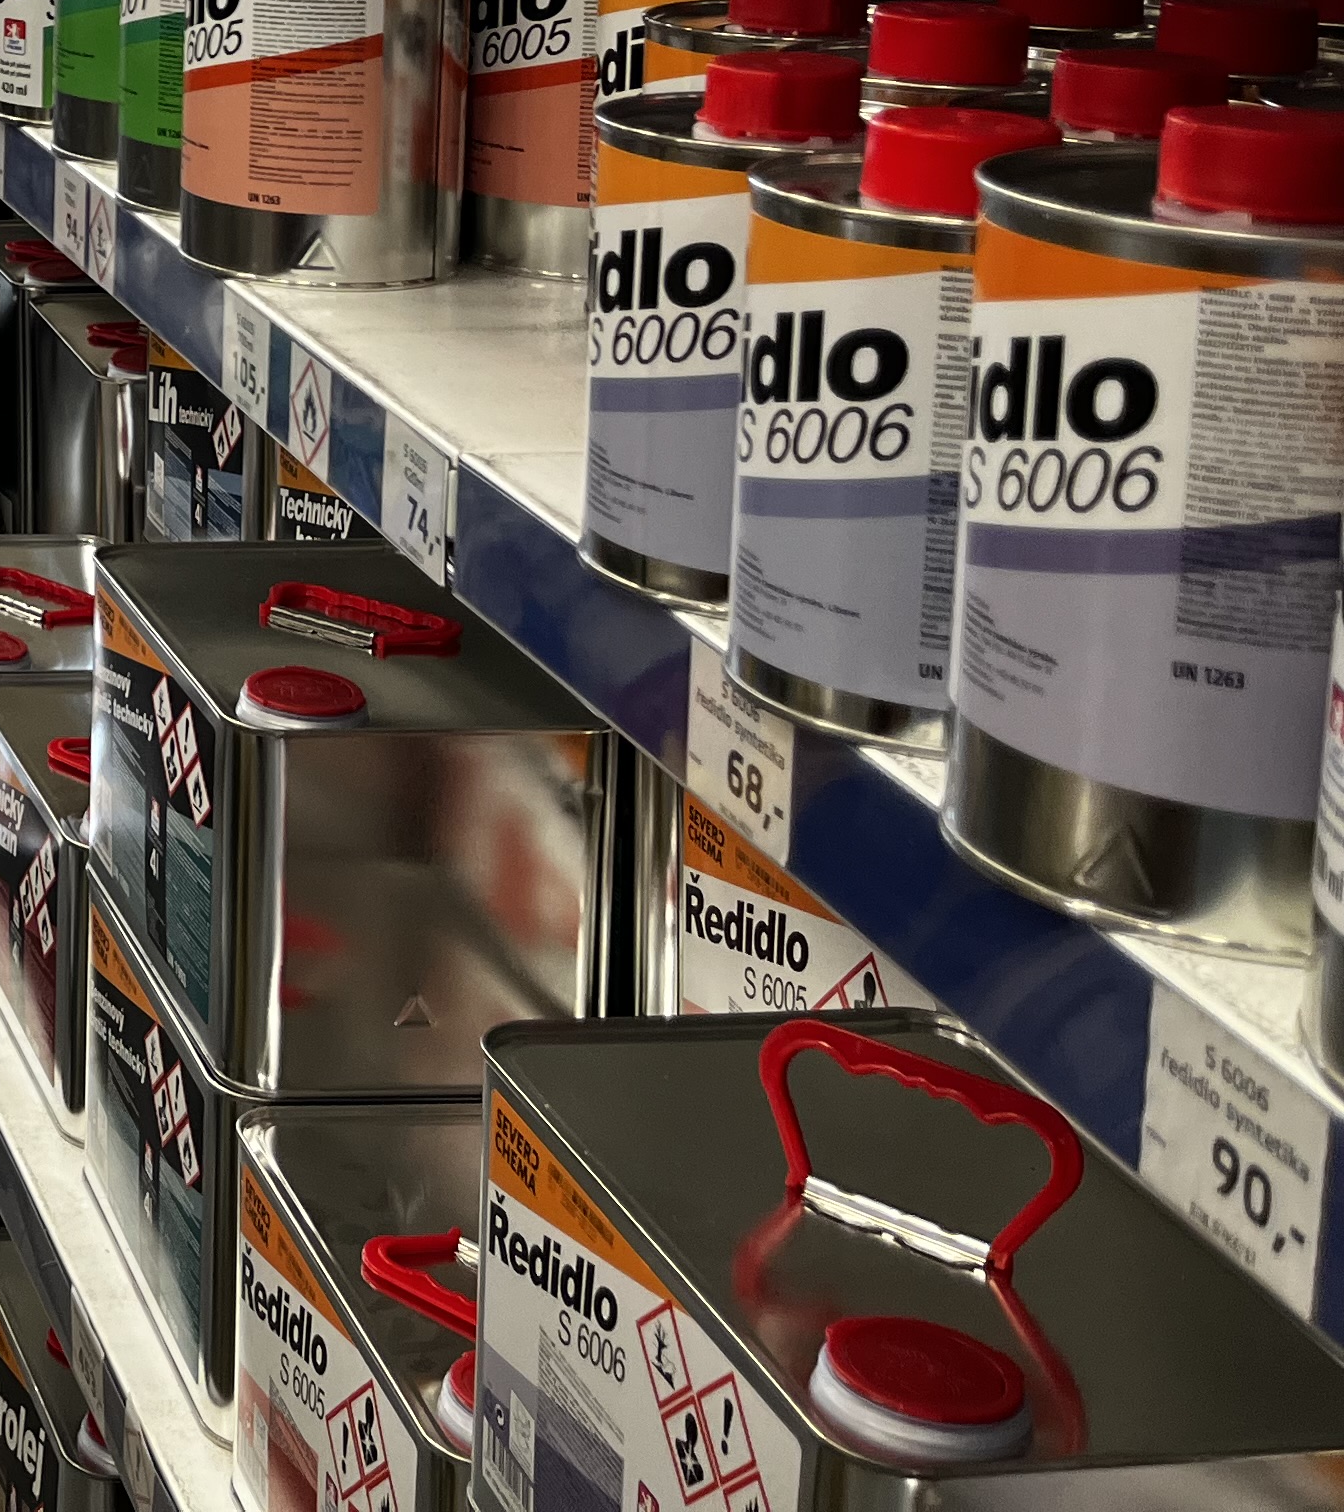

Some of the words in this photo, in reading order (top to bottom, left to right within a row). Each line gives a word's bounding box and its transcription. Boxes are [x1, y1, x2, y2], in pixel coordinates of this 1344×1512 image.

[186, 18, 243, 64] 6005
[483, 17, 572, 68] 6005
[611, 308, 739, 367] 6006
[149, 367, 179, 426] Líh
[178, 402, 215, 430] technický
[231, 348, 267, 405] 105,-
[765, 402, 913, 465] 6006
[279, 486, 354, 531] Technický
[965, 447, 985, 511] S
[996, 444, 1165, 515] 6006
[405, 493, 444, 554] 74,-
[918, 663, 943, 682] UN
[1172, 662, 1198, 683] UN
[1204, 665, 1245, 690] 1263
[724, 748, 786, 832] 68,-
[688, 803, 726, 849] SEVERO
[688, 823, 724, 868] CHEMA
[685, 872, 809, 975] Ředidlo
[742, 965, 757, 997] S
[761, 970, 808, 1012] 6005
[1205, 1045, 1218, 1075] S
[1220, 1056, 1271, 1116] 6006
[494, 1108, 541, 1172] SEVERO
[1158, 1045, 1222, 1117] ředidlo
[1225, 1102, 1311, 1184] syntetika
[493, 1131, 539, 1197] CHEMA
[1211, 1138, 1307, 1253] 90,-
[487, 1190, 619, 1333] Ředidlo
[239, 1248, 329, 1378] Ředidlo
[556, 1311, 572, 1347] S
[576, 1329, 628, 1383] 6006
[279, 1352, 291, 1385] S
[293, 1366, 327, 1422] 6005
